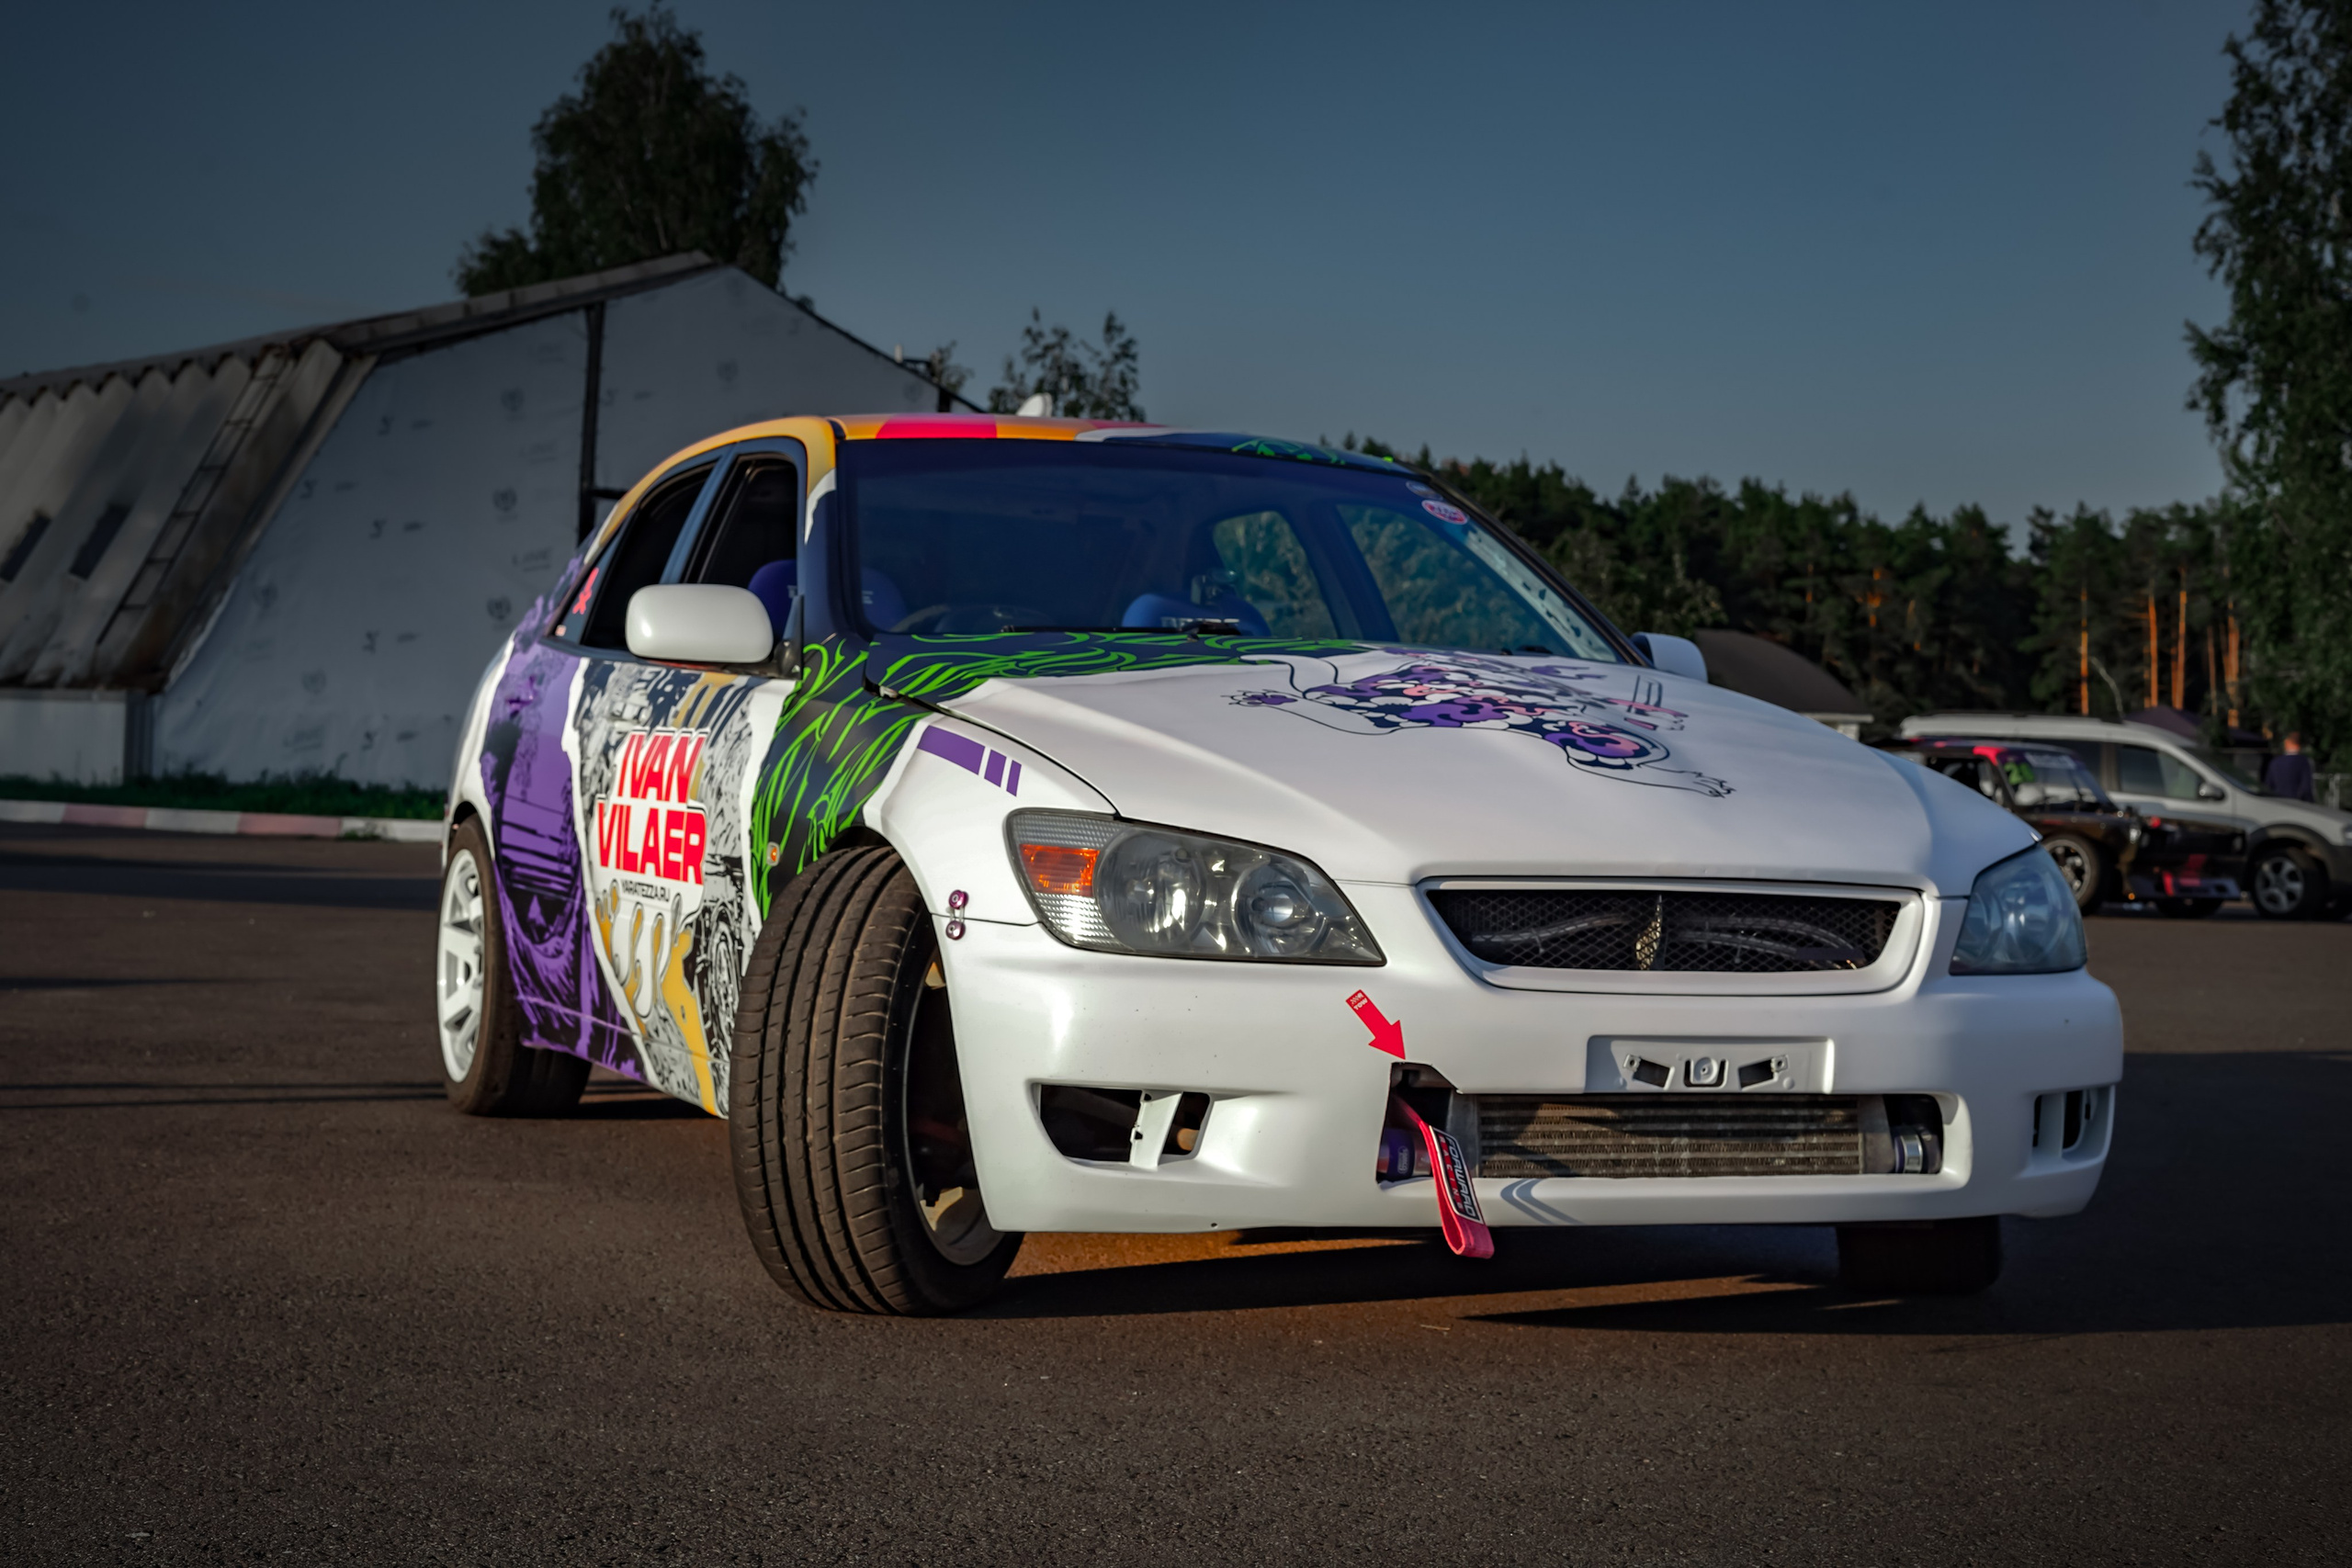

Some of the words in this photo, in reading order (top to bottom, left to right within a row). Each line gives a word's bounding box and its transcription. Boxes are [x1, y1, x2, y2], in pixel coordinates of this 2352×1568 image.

[618, 734, 706, 803] IVAN
[597, 802, 707, 885] VILAER
[1353, 998, 1368, 1010] TOW
[1439, 1135, 1464, 1209] RACING
[1446, 1136, 1476, 1217] FORWARD
